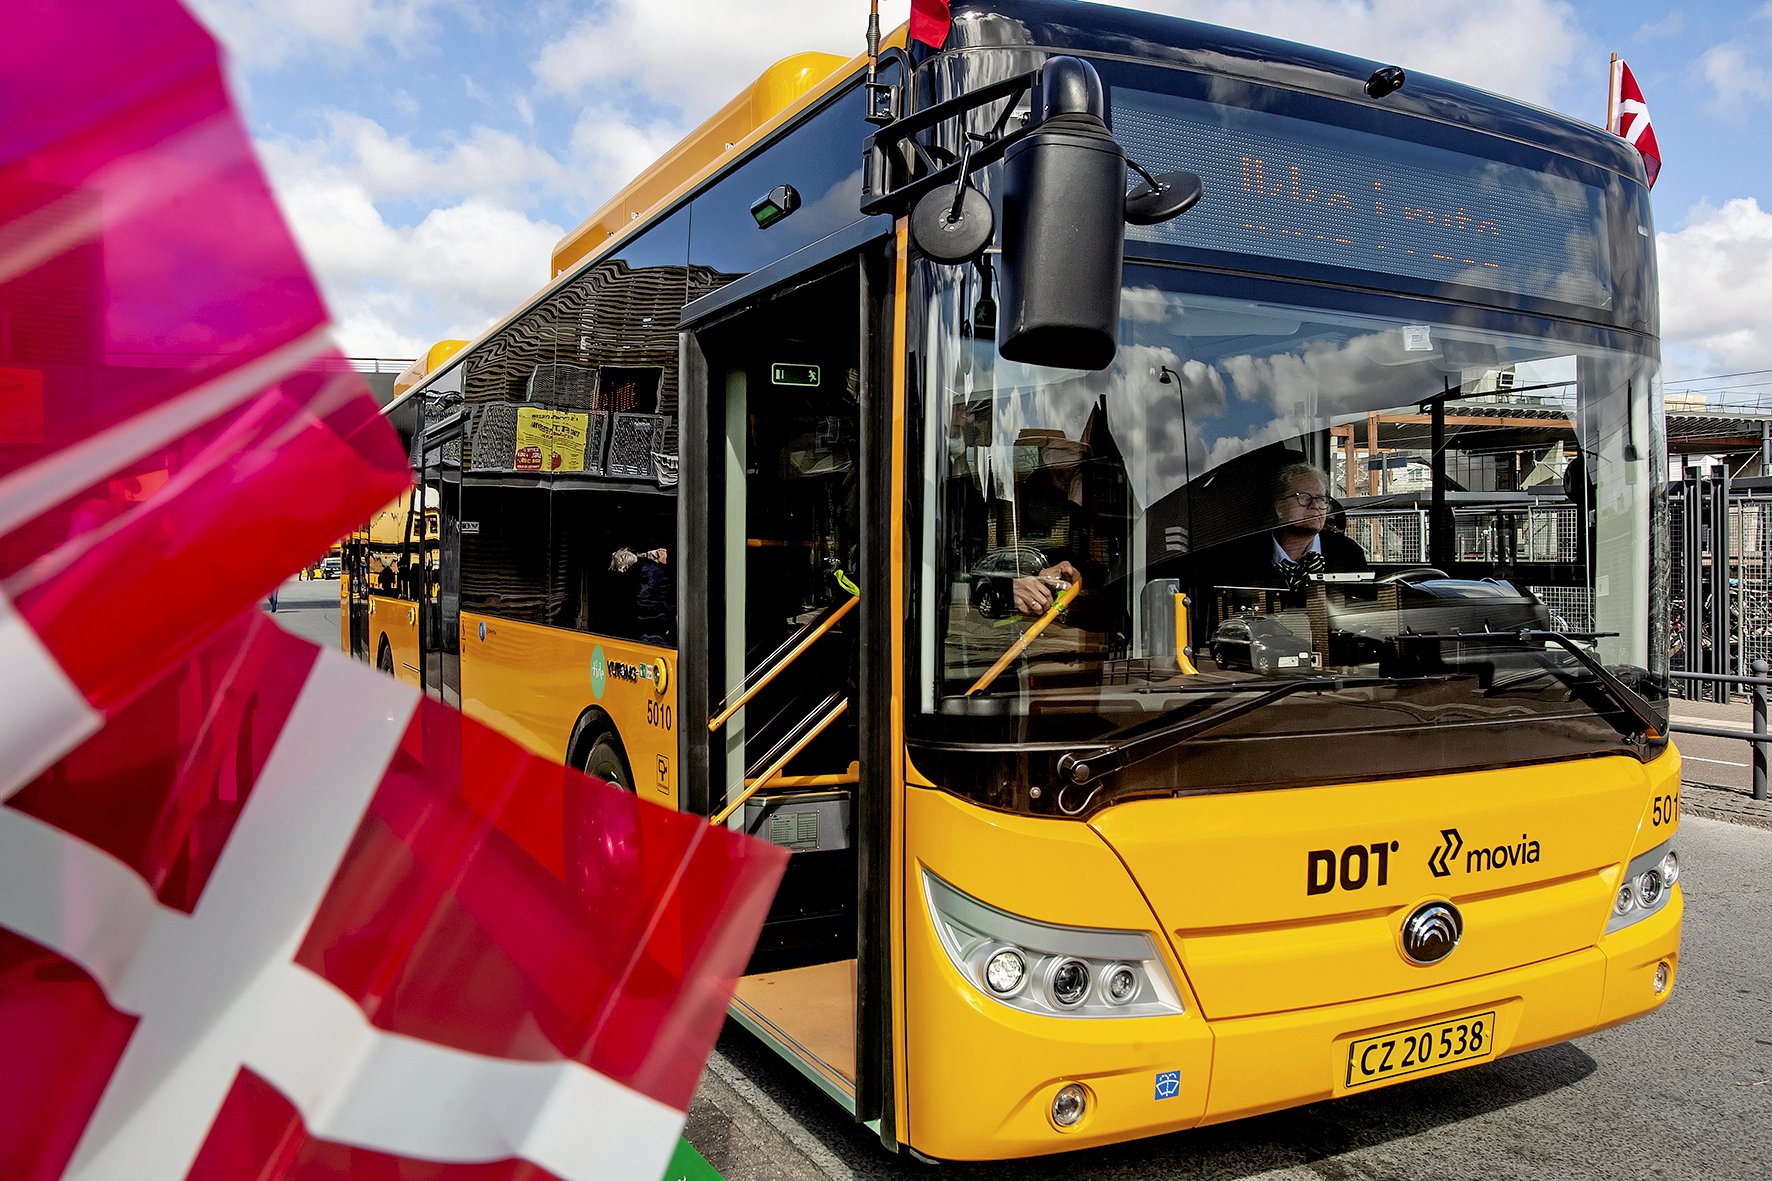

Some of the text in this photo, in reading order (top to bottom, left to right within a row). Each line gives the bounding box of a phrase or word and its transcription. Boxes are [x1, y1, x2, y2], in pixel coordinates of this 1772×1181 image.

[646, 698, 672, 732] 5010
[1652, 791, 1679, 827] 501
[1306, 840, 1399, 896] DOT
[1466, 832, 1541, 874] movia
[1360, 1020, 1484, 1076] CZ 20 538
